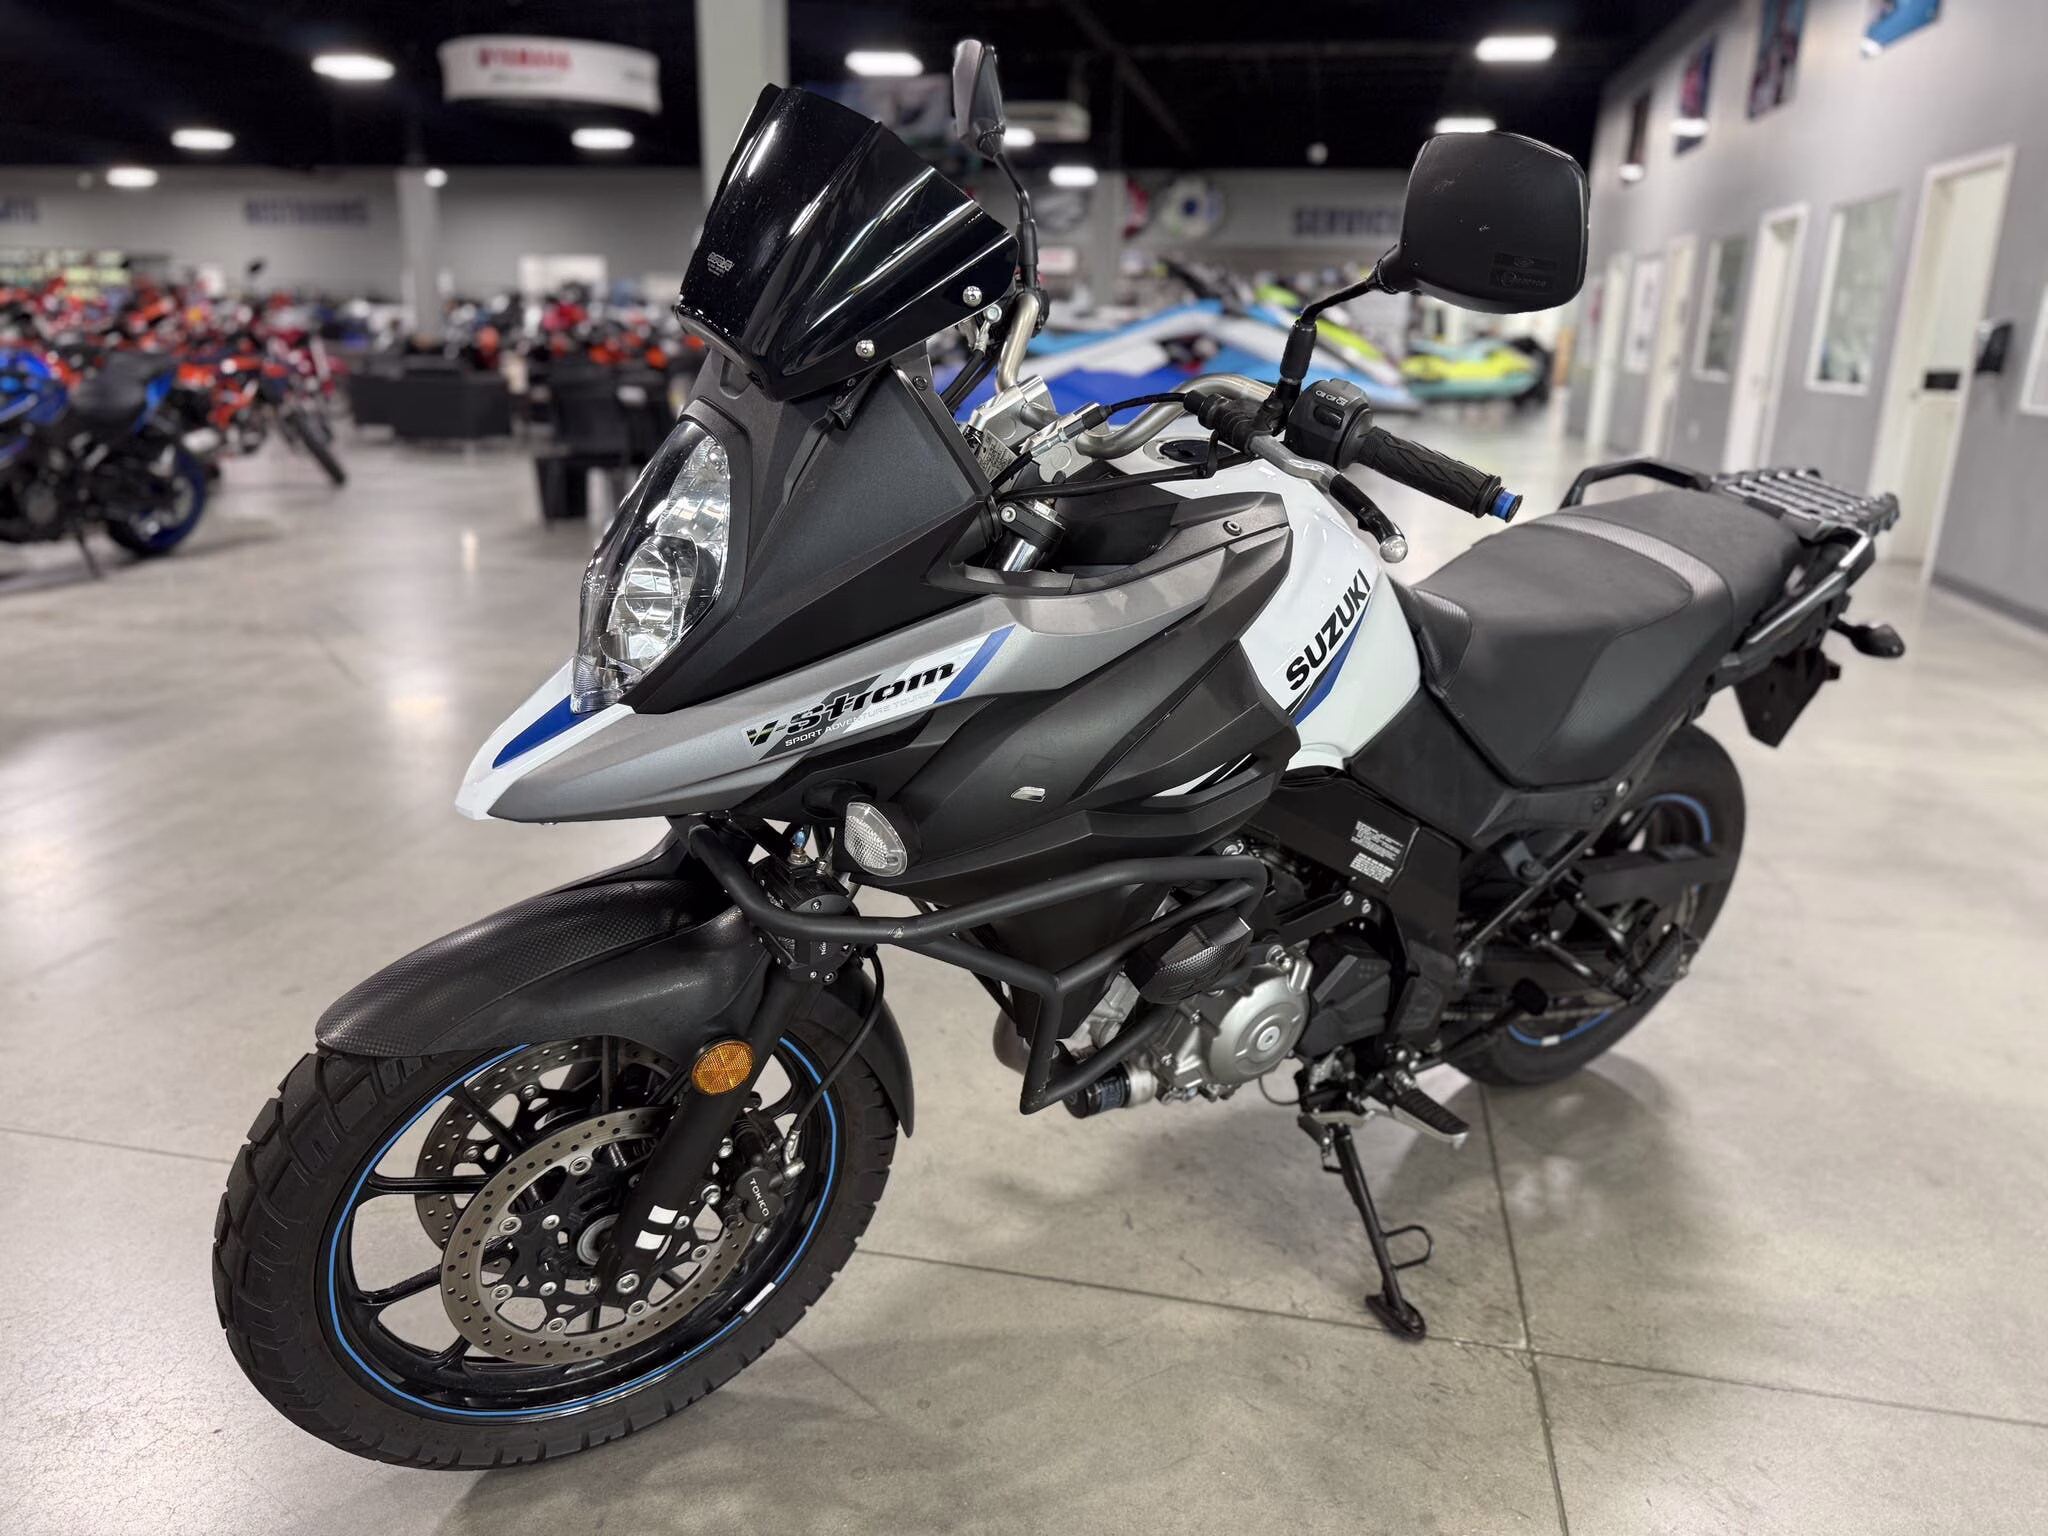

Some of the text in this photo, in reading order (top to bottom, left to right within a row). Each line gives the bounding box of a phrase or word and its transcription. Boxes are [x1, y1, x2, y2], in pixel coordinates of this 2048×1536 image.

[1286, 568, 1371, 691] SUZUKI
[785, 687, 938, 747] SPORT ADVENTURE TOURER
[750, 1177, 770, 1217] TOKICO
